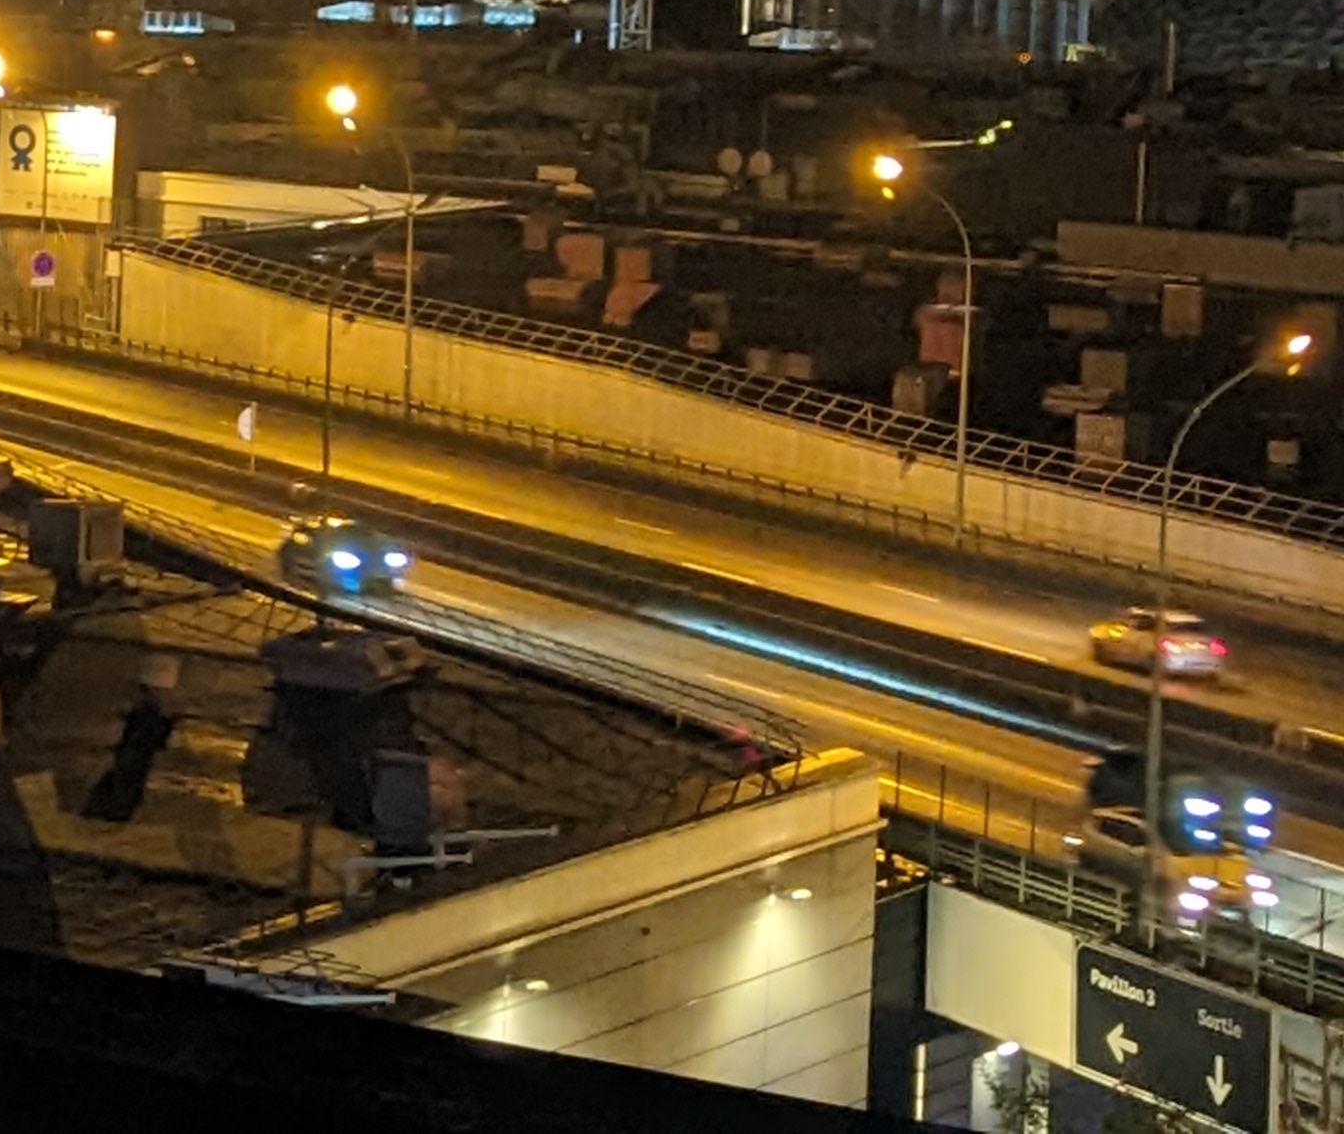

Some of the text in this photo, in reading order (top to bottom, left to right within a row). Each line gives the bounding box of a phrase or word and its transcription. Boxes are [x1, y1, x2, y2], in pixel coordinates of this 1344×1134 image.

[1090, 968, 1156, 1007] Pavillon 3
[1197, 1008, 1242, 1039] Sortie
